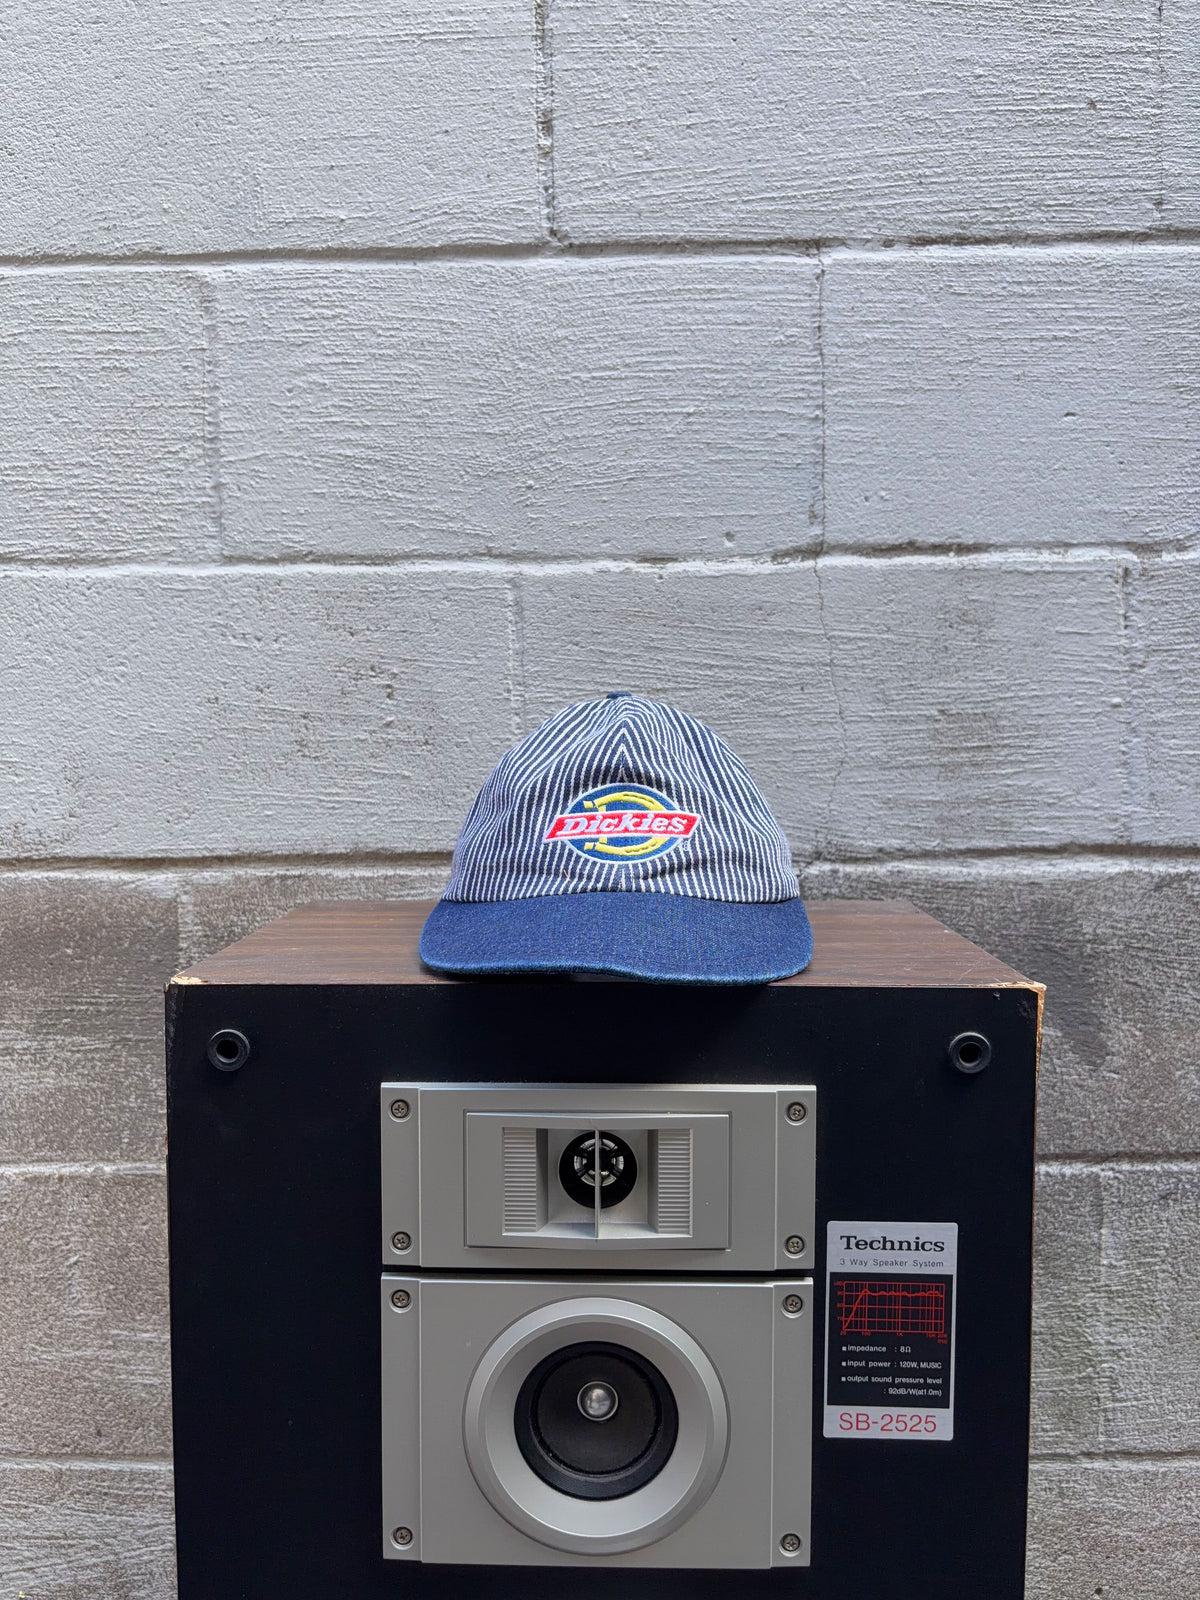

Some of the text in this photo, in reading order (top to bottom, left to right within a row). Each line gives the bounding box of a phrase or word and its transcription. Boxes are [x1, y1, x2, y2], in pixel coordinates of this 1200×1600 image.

[556, 814, 687, 836] Dickies
[840, 1235, 945, 1252] Technics
[840, 1258, 944, 1269] 3 Way Speaker System
[847, 1344, 887, 1353] impedance
[847, 1360, 866, 1368] input
[900, 1361, 919, 1369] 120W,
[839, 1412, 937, 1433] SB-2525
